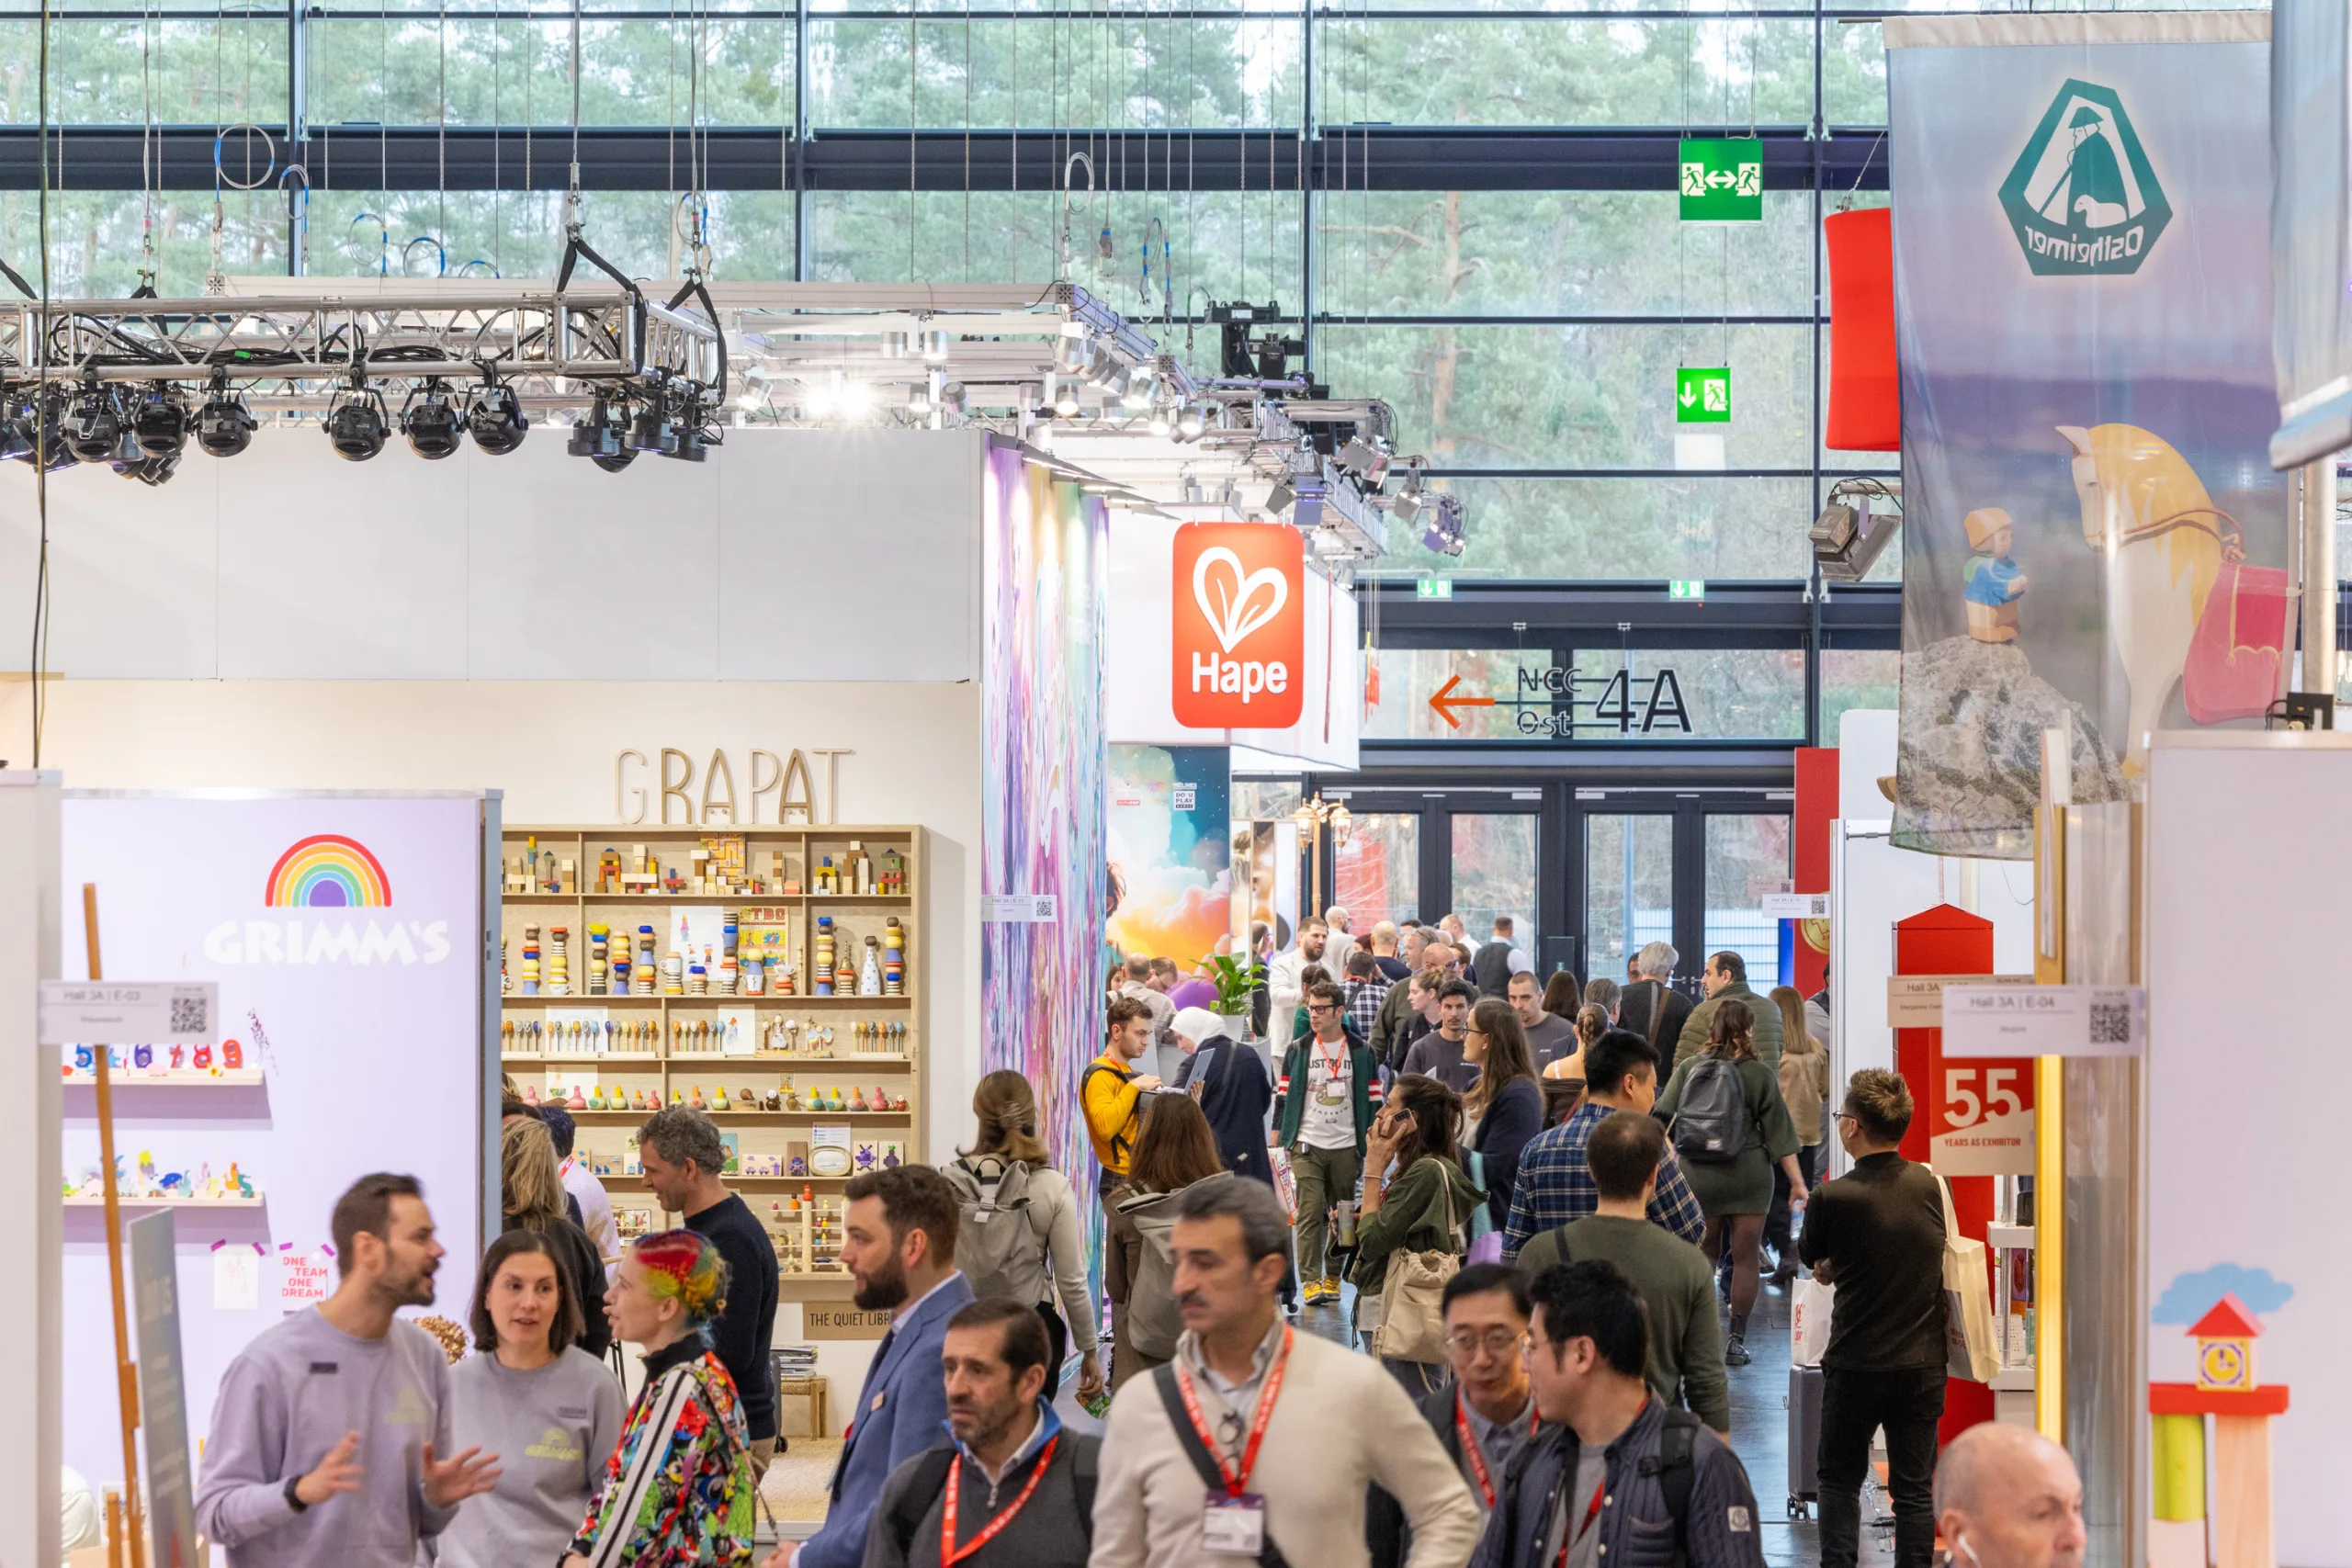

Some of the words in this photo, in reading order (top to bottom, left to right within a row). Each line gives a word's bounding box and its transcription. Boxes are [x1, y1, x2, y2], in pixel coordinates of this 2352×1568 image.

[1192, 651, 1288, 704] Hape
[1518, 668, 1582, 694] NCC
[1596, 668, 1693, 734] 4A
[1517, 710, 1570, 735] Ost
[615, 748, 852, 824] GRAPAT
[752, 908, 785, 919] TBO
[202, 919, 452, 966] GRIMM'S
[1906, 982, 1925, 992] Hall
[1928, 982, 1939, 992] 3A
[63, 989, 85, 1001] Hall
[89, 990, 104, 1001] 3A
[1970, 996, 1995, 1009] Hall
[1998, 996, 2015, 1008] 3A
[2025, 996, 2055, 1008] E-04
[1943, 1068, 2021, 1128] 55
[1944, 1138, 1969, 1147] YEARS
[1971, 1138, 1980, 1147] AS
[1983, 1137, 2021, 1147] EXHIBITOR
[283, 1257, 307, 1266] ONE
[294, 1268, 328, 1277] TEAM
[288, 1278, 313, 1287] ONE
[282, 1288, 324, 1298] DREAM
[809, 1313, 830, 1326] THE
[833, 1313, 864, 1328] QUIET
